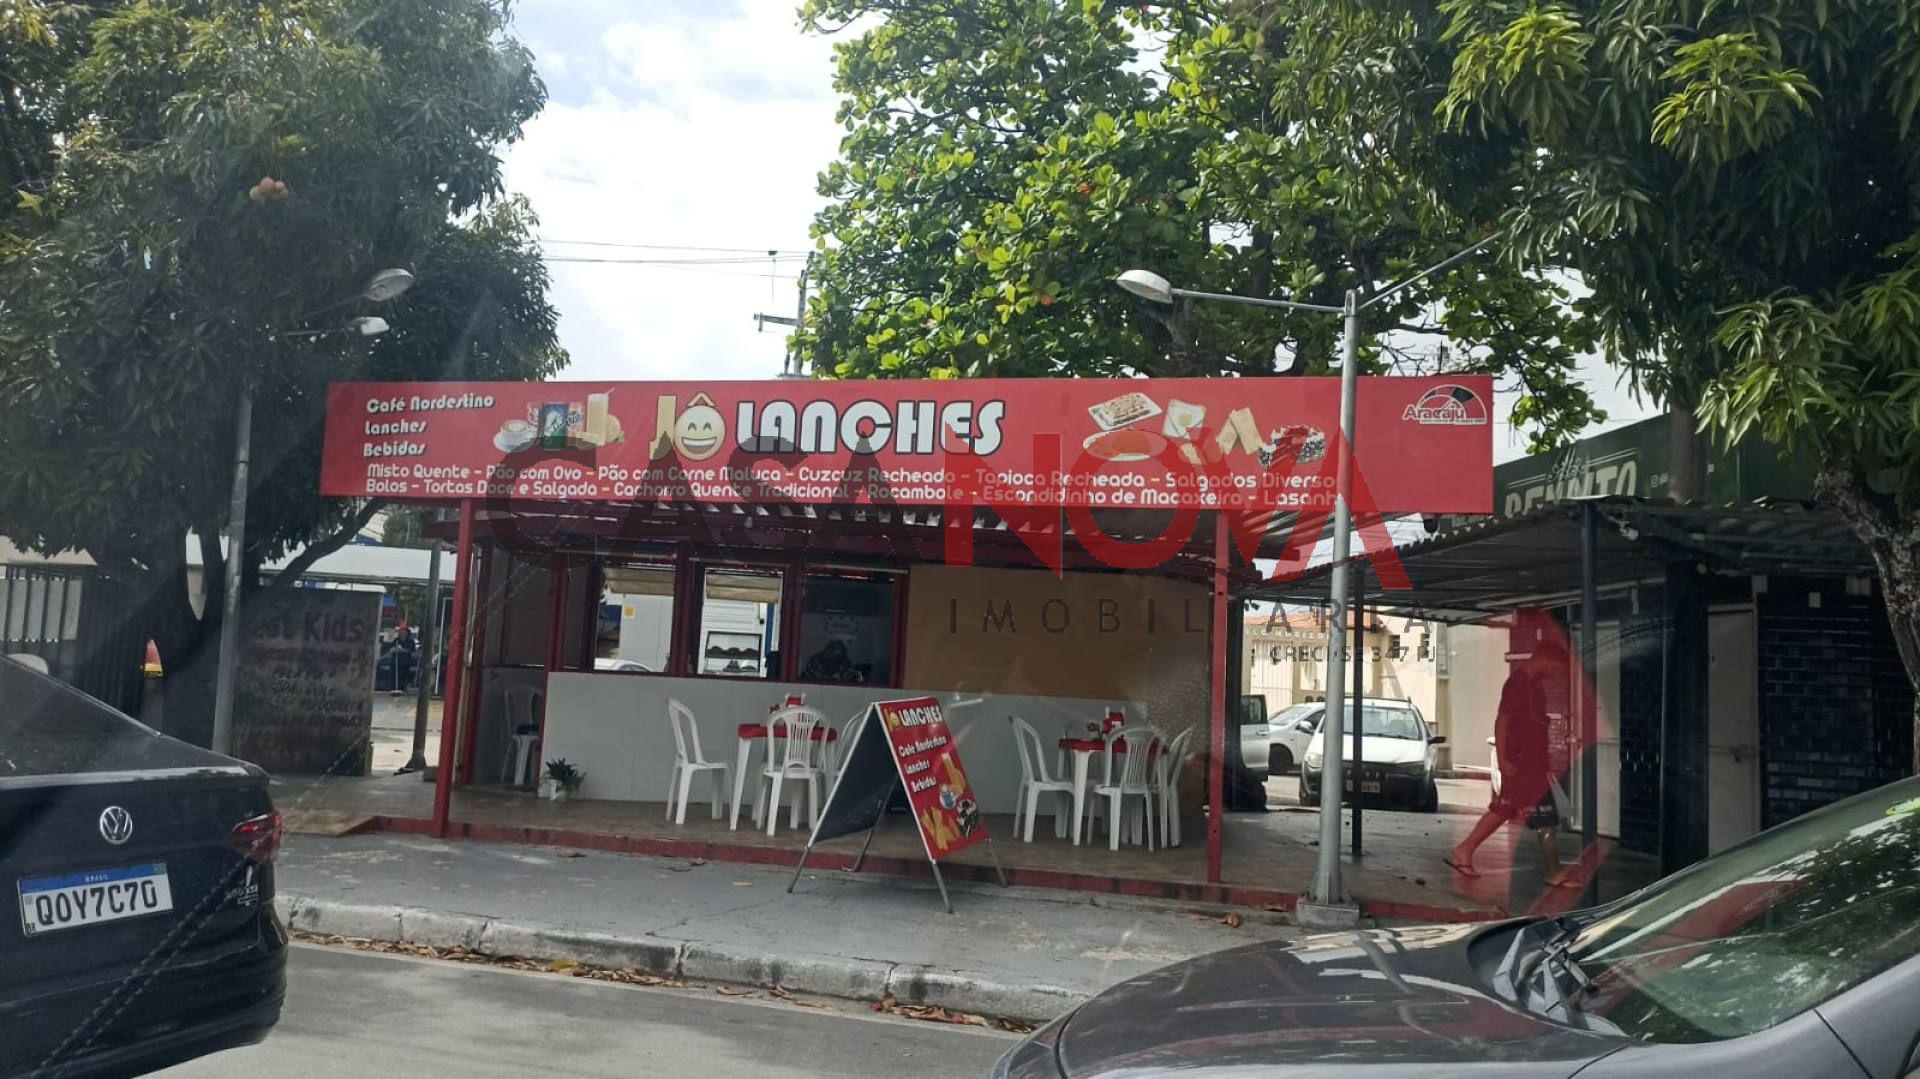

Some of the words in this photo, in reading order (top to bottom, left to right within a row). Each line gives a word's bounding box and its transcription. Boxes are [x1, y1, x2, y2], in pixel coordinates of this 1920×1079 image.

[366, 398, 406, 413] Café
[410, 393, 494, 411] Nordestino
[1402, 404, 1465, 422] Aracaju
[365, 419, 427, 435] Lanches
[735, 399, 1006, 456] LANCHES
[363, 441, 426, 457] Bebidas
[368, 463, 410, 478] Misto
[413, 463, 470, 479] Quente
[486, 463, 515, 479] Pão
[520, 468, 549, 480] com
[553, 466, 582, 480] Ovo
[598, 464, 628, 480] Pão
[632, 468, 666, 481] com
[668, 466, 715, 481] Carne
[719, 467, 780, 481] Maluca
[800, 466, 863, 482] Cuzcuz
[868, 467, 956, 483] Recheado
[975, 468, 1046, 488] Tapioca
[1051, 471, 1145, 487] Recheada
[1165, 472, 1257, 492] Salgados
[1262, 472, 1339, 488] Diverso
[366, 479, 407, 494] Bolos
[424, 479, 473, 494] Tortas
[477, 480, 515, 494] Doce
[519, 483, 529, 494] e
[533, 481, 597, 499] Salgada
[614, 481, 686, 497] Cachorro
[691, 482, 752, 498] Quente
[757, 483, 848, 498] Tradicional
[867, 484, 964, 500] Rocambole
[983, 485, 1107, 504] Escondidinho
[1111, 488, 1135, 504] de
[1141, 488, 1241, 505] Macaxeira
[1264, 490, 1338, 507] Lasanh
[898, 705, 943, 727] LANCHES
[85, 874, 110, 884] BRASIL
